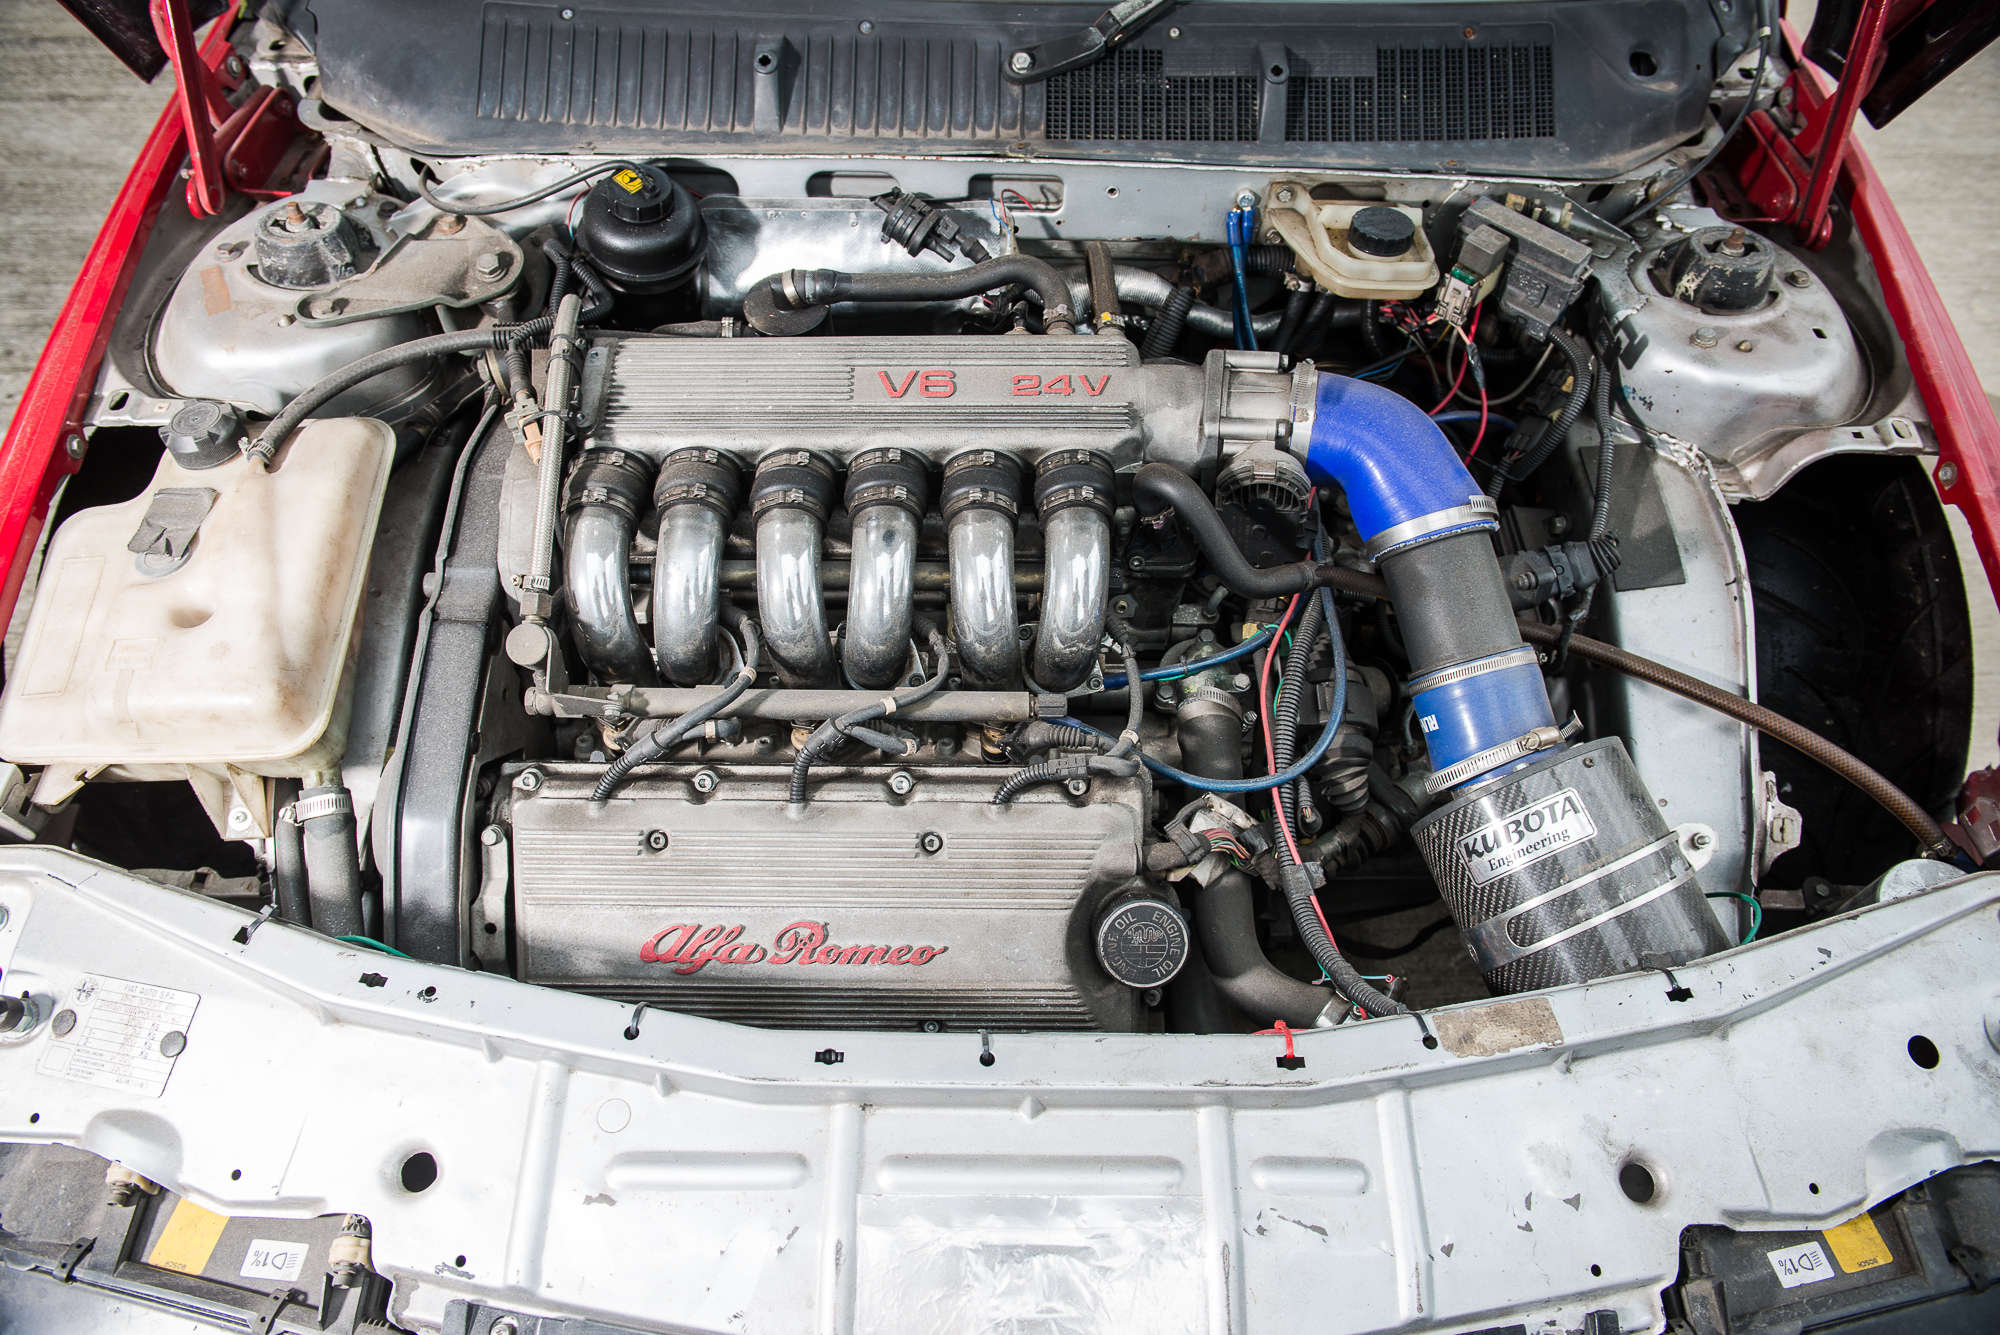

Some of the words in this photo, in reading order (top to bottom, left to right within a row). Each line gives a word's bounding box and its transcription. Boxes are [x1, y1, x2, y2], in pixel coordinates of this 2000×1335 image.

[877, 369, 958, 398] V6
[1011, 374, 1112, 397] 24V
[1463, 795, 1581, 862] KUBOTA
[1488, 829, 1571, 871] Engineering
[1114, 911, 1137, 930] OIL
[1152, 910, 1182, 957] ENGINE
[640, 923, 767, 975] Alfa
[767, 920, 949, 965] Romeo
[1107, 933, 1137, 978] ENGINE
[1151, 959, 1174, 978] OIL
